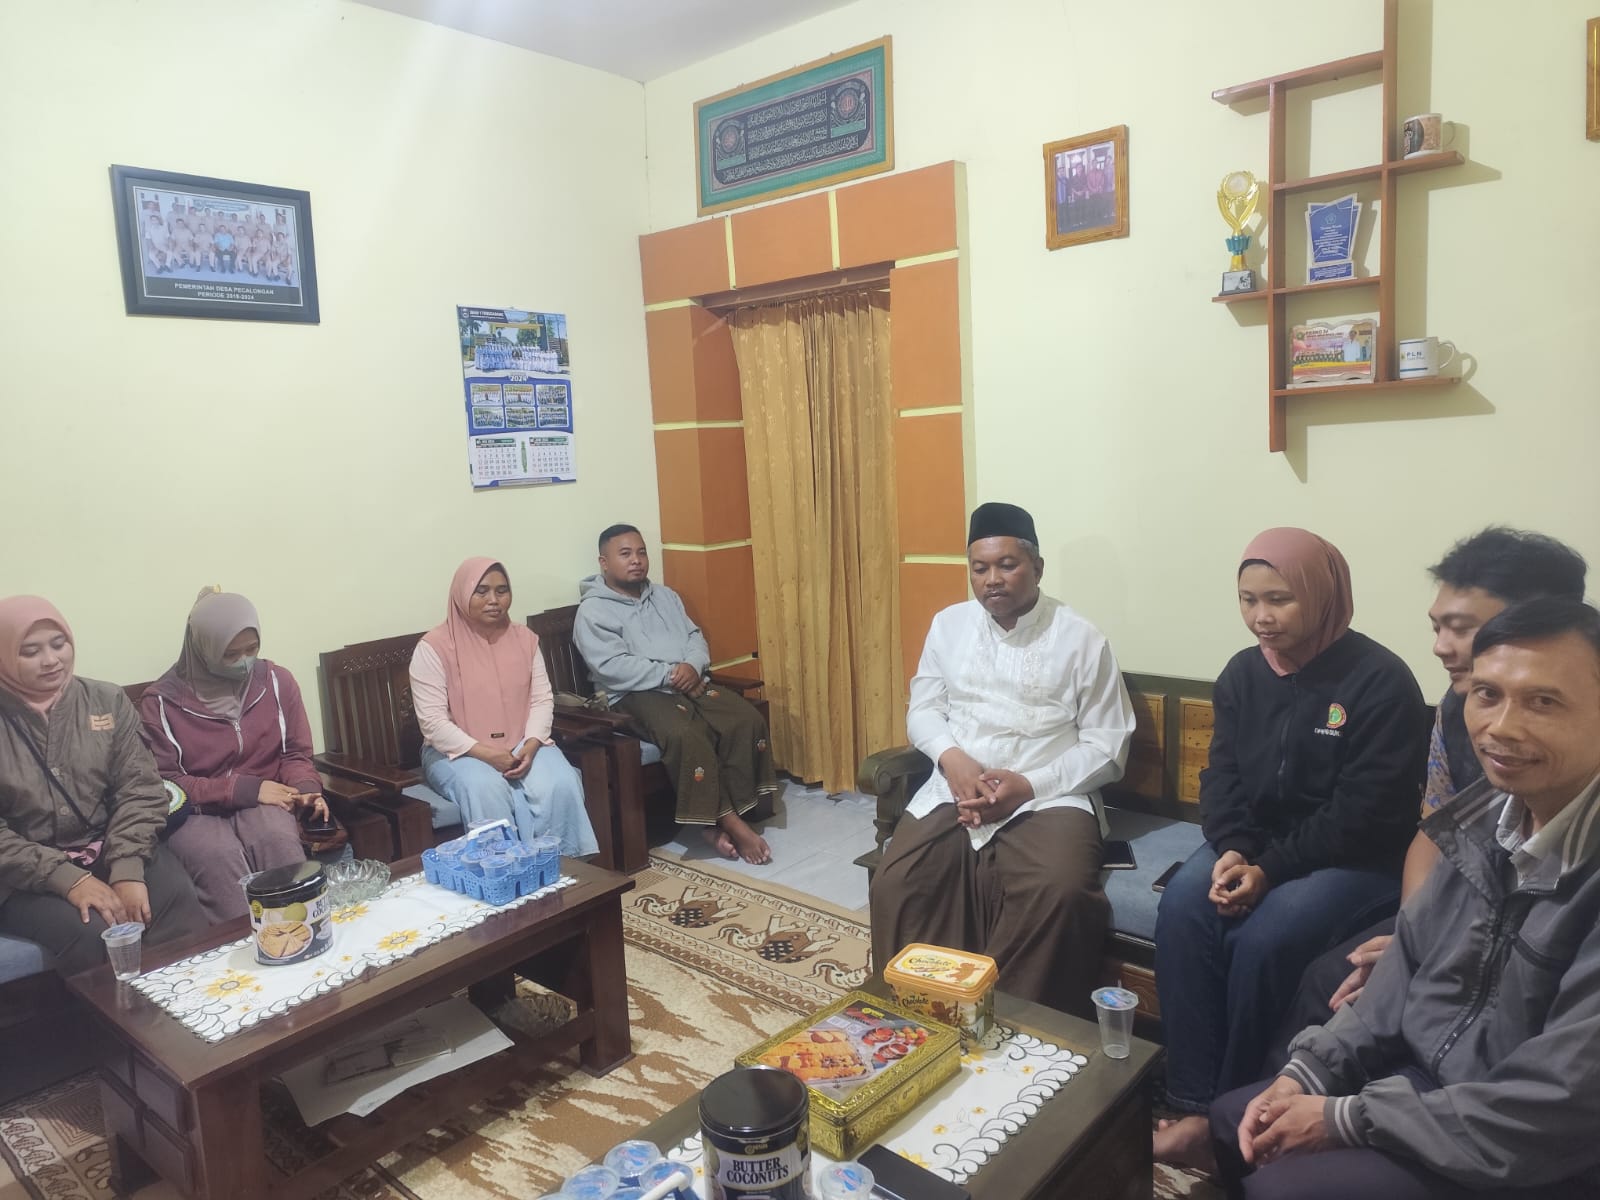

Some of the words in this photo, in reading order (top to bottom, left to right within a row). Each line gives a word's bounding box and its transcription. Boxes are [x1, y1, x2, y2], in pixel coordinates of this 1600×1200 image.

[174, 283, 214, 291] PEMERINTAH
[733, 1157, 781, 1173] BUTTER
[726, 1165, 789, 1184] COCONUTS
